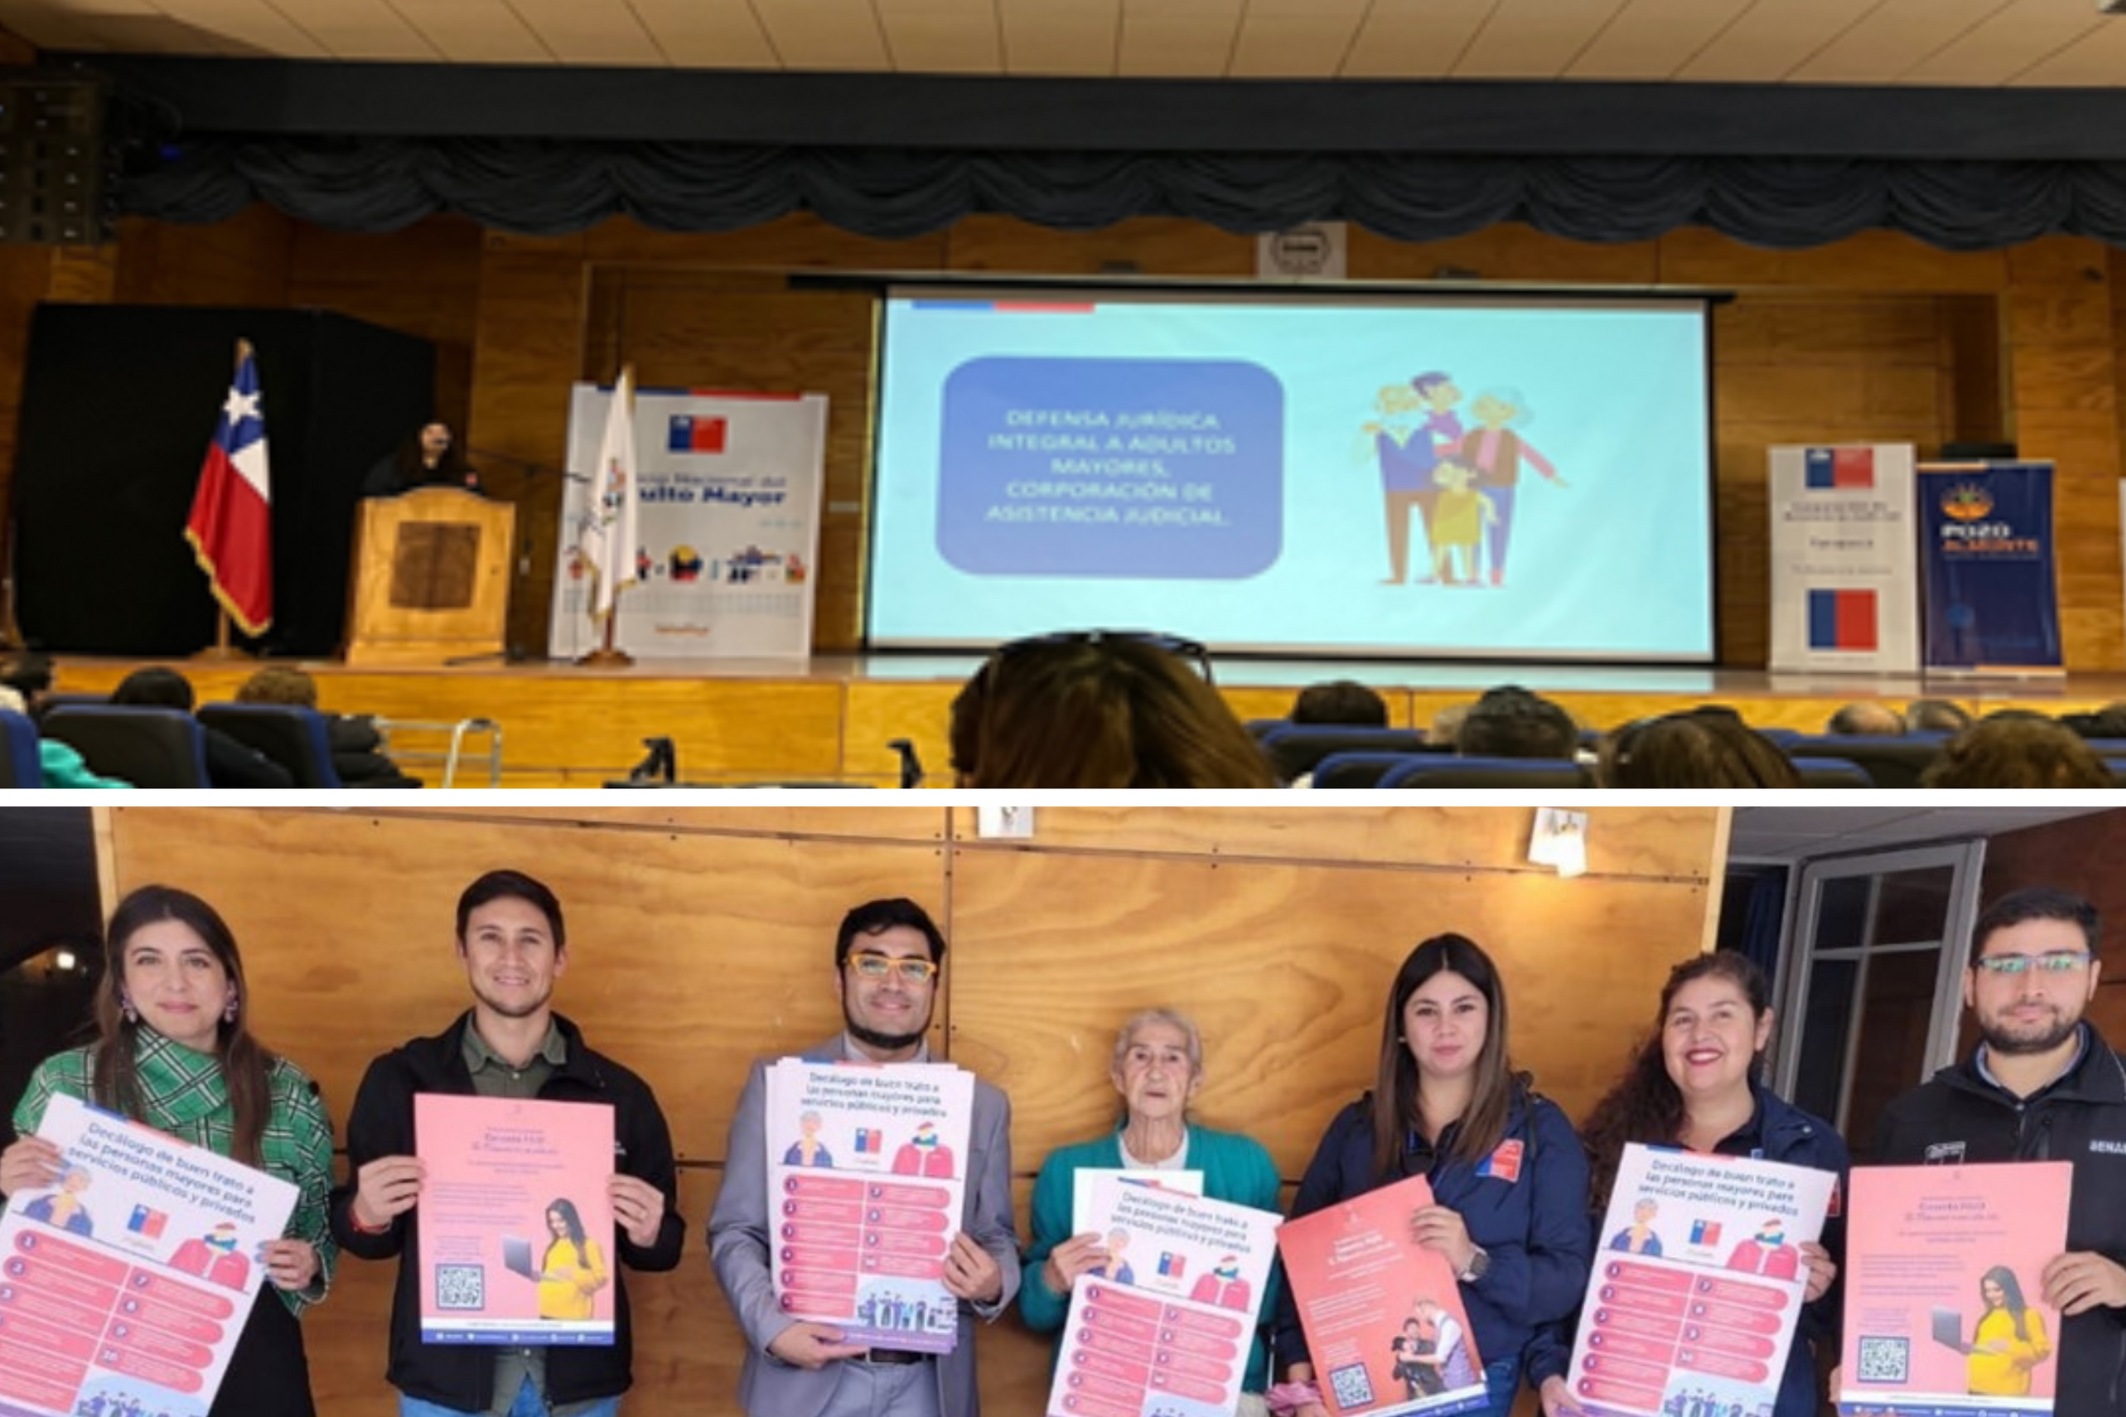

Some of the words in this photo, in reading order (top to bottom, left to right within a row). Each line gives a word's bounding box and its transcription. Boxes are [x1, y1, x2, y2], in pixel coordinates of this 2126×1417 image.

[1006, 409, 1109, 427] DEFENSA
[1114, 409, 1220, 430] JURÍDICA
[987, 434, 1097, 452] INTEGRAL
[1105, 435, 1124, 451] A
[1128, 435, 1236, 454] ADULTOS
[639, 486, 694, 502] ulto
[702, 485, 786, 508] Mayor
[1006, 477, 1177, 500] CORPORACIÓN
[1183, 482, 1214, 500] DE
[984, 505, 1119, 523] ASISTENCIA
[1940, 522, 2012, 539] POZO
[80, 1133, 99, 1150] las
[101, 1143, 163, 1175] personas
[165, 1168, 221, 1197] mayores
[224, 1188, 252, 1208] para
[157, 1149, 174, 1163] de
[176, 1156, 210, 1178] buen
[213, 1171, 244, 1191] trato
[1707, 1168, 1722, 1178] de
[1724, 1169, 1753, 1182] buen
[1756, 1174, 1786, 1188] trato
[68, 1146, 128, 1176] servicios
[200, 1196, 256, 1224] privados
[1645, 1171, 1661, 1182] las
[1663, 1175, 1713, 1190] personas
[1716, 1182, 1764, 1198] mayores
[1767, 1189, 1794, 1203] para
[1638, 1184, 1685, 1198] servicios
[1748, 1200, 1798, 1217] privados
